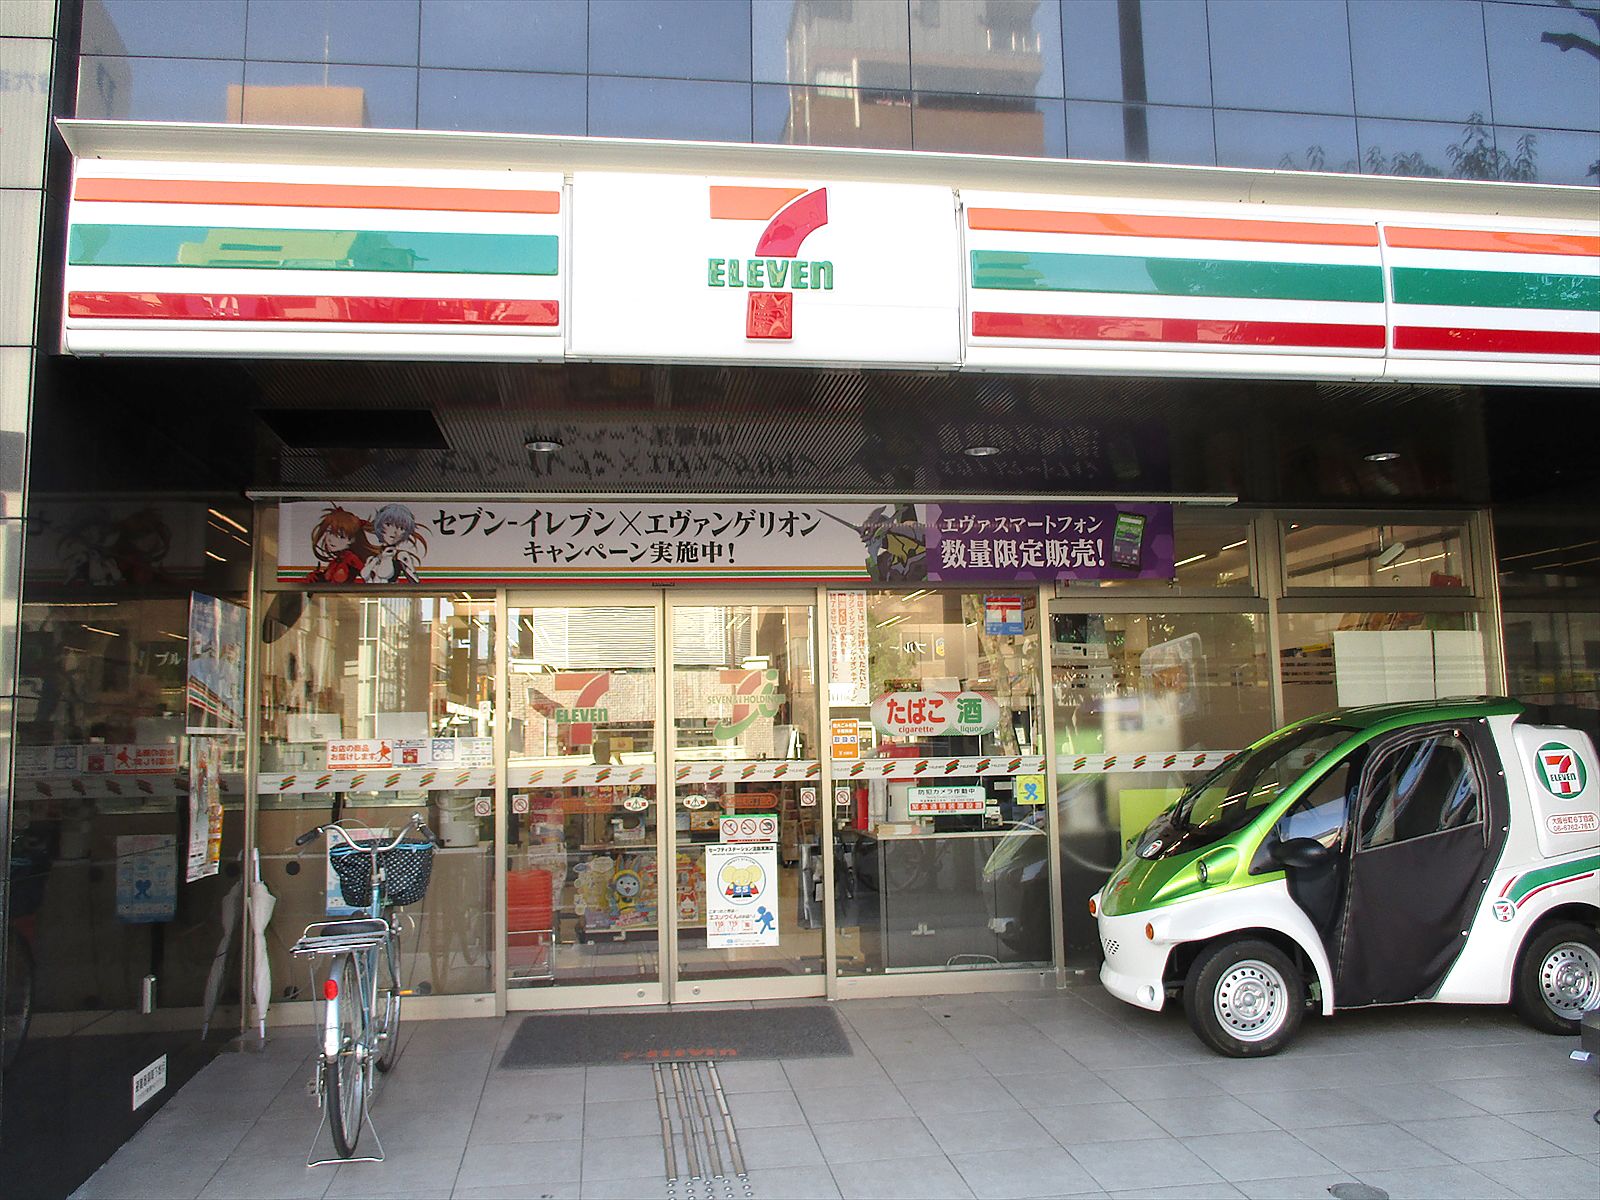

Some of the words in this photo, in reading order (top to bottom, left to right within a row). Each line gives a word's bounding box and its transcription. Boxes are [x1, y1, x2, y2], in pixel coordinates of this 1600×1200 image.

[941, 514, 1104, 535] エヴァスマートフォン
[523, 540, 735, 564] キャンペーン実施中!
[941, 538, 1105, 569] 数量限定販売!
[707, 695, 733, 704] SEVEN
[743, 695, 785, 704] HOLDIN
[886, 697, 946, 725] たばこ
[956, 697, 982, 724] 酒
[898, 725, 934, 734] cigarette
[960, 725, 984, 733] liquor
[918, 788, 976, 796] 防犯カメラ作動中
